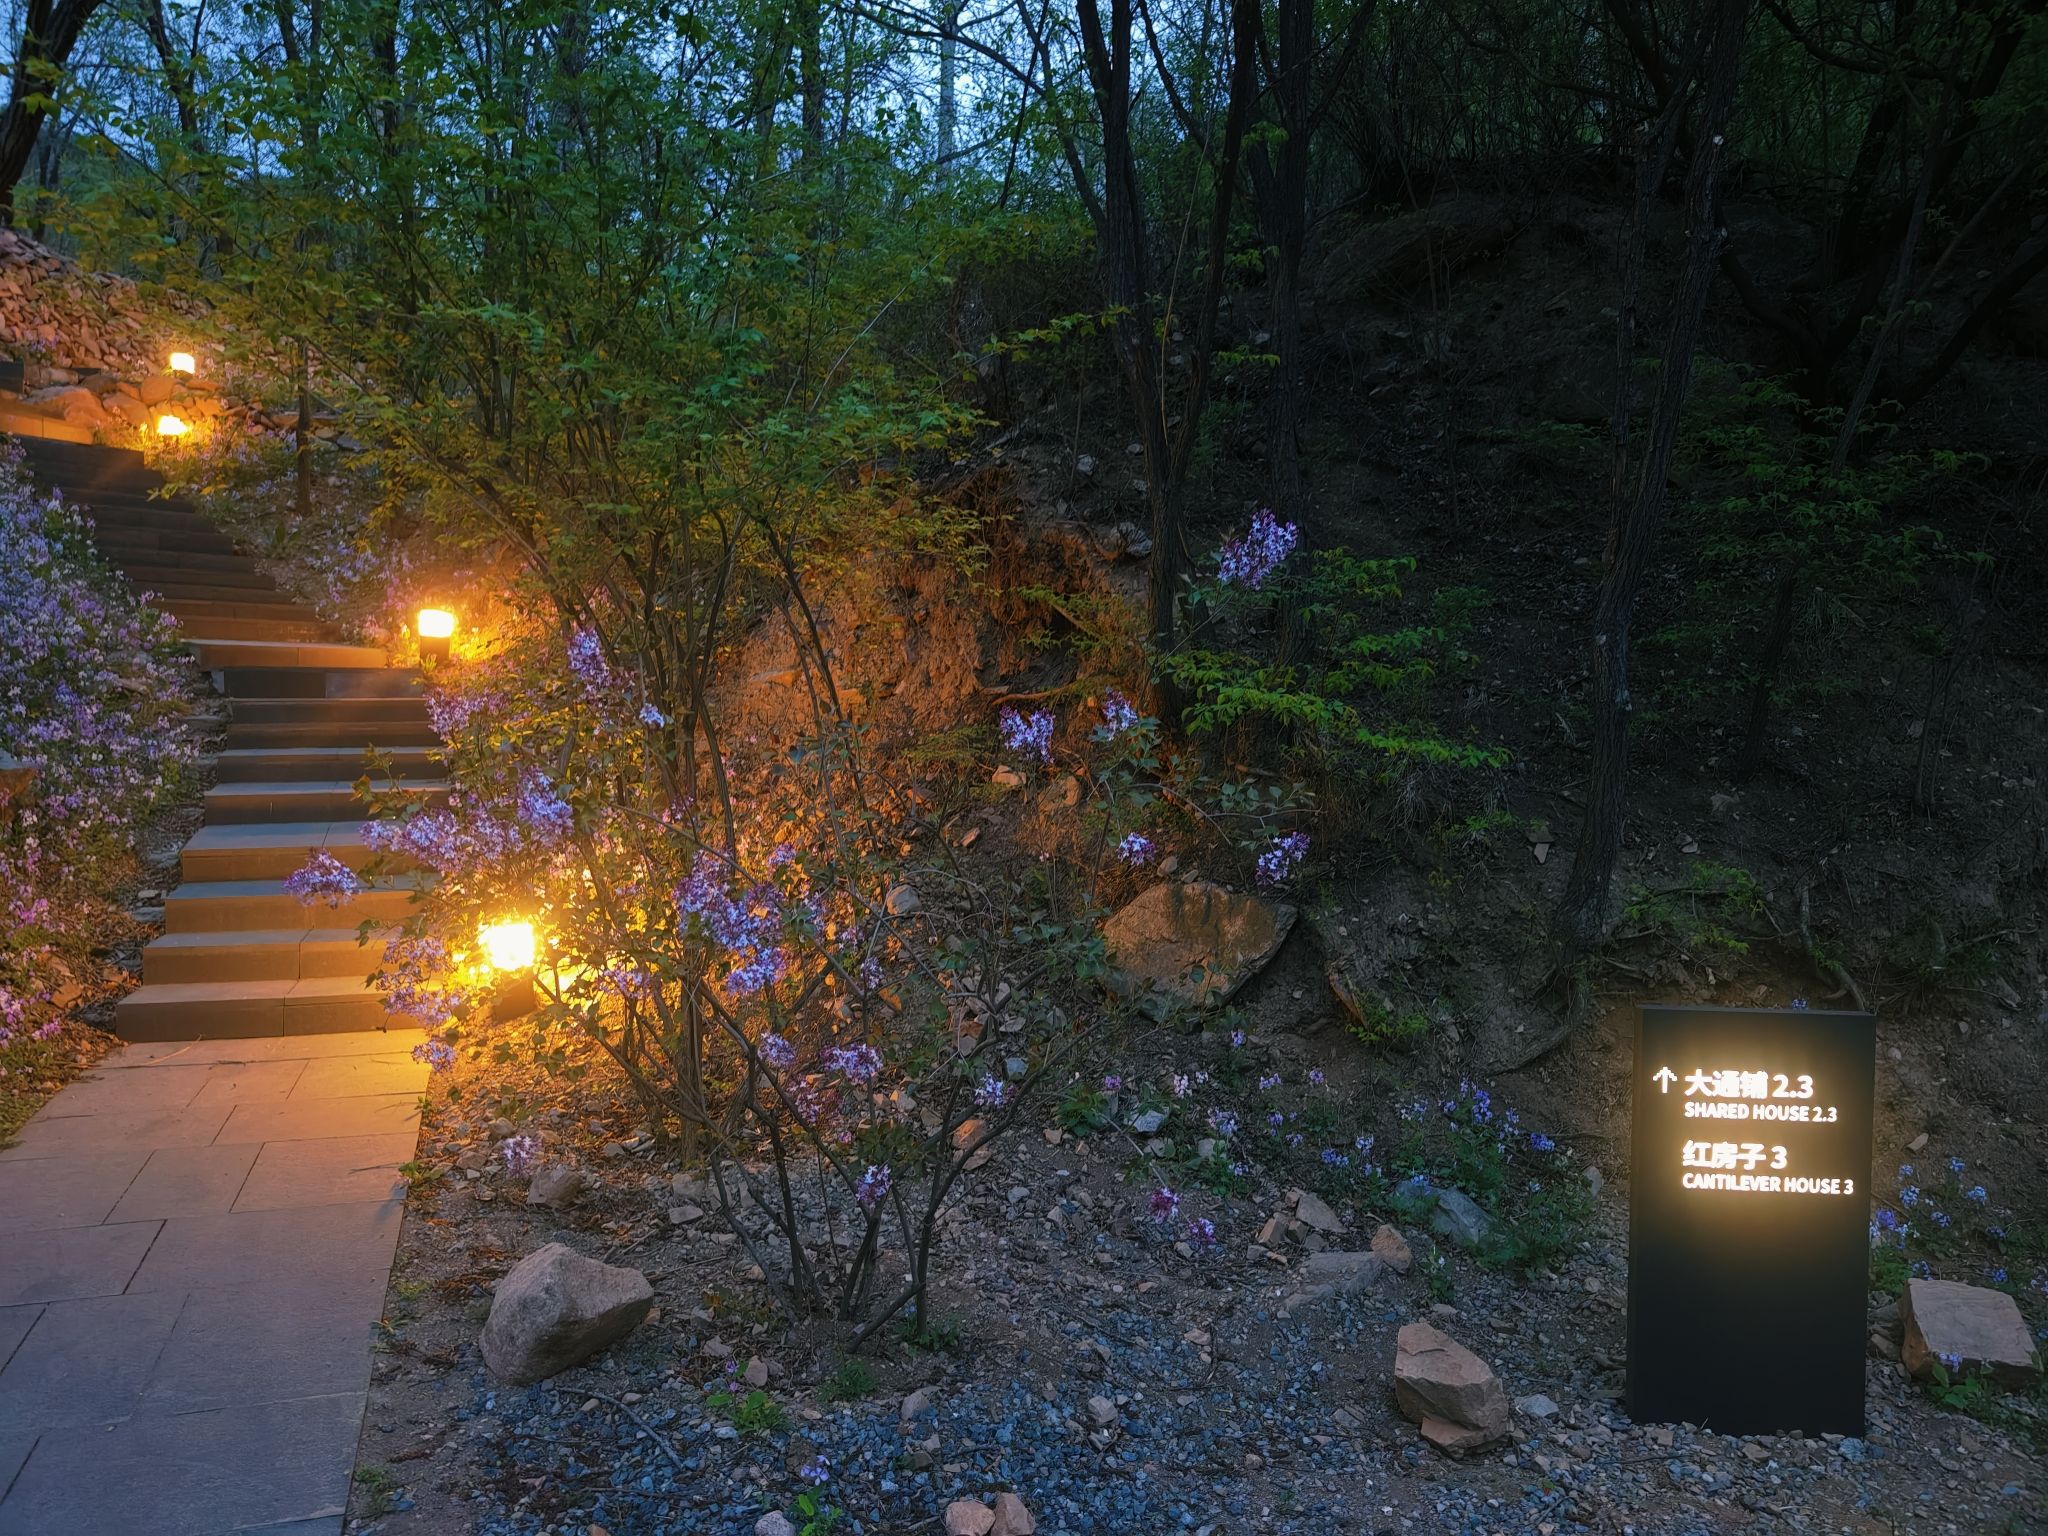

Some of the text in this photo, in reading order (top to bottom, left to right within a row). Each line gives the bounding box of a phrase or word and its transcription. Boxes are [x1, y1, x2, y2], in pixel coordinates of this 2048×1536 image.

[1684, 1069, 1814, 1099] 大通铺 2.3
[1684, 1102, 1838, 1122] SHARED HOUSE 2.3
[1682, 1139, 1788, 1170] 红房子 3
[1682, 1173, 1854, 1195] CANTILEVER HOUSE 3
